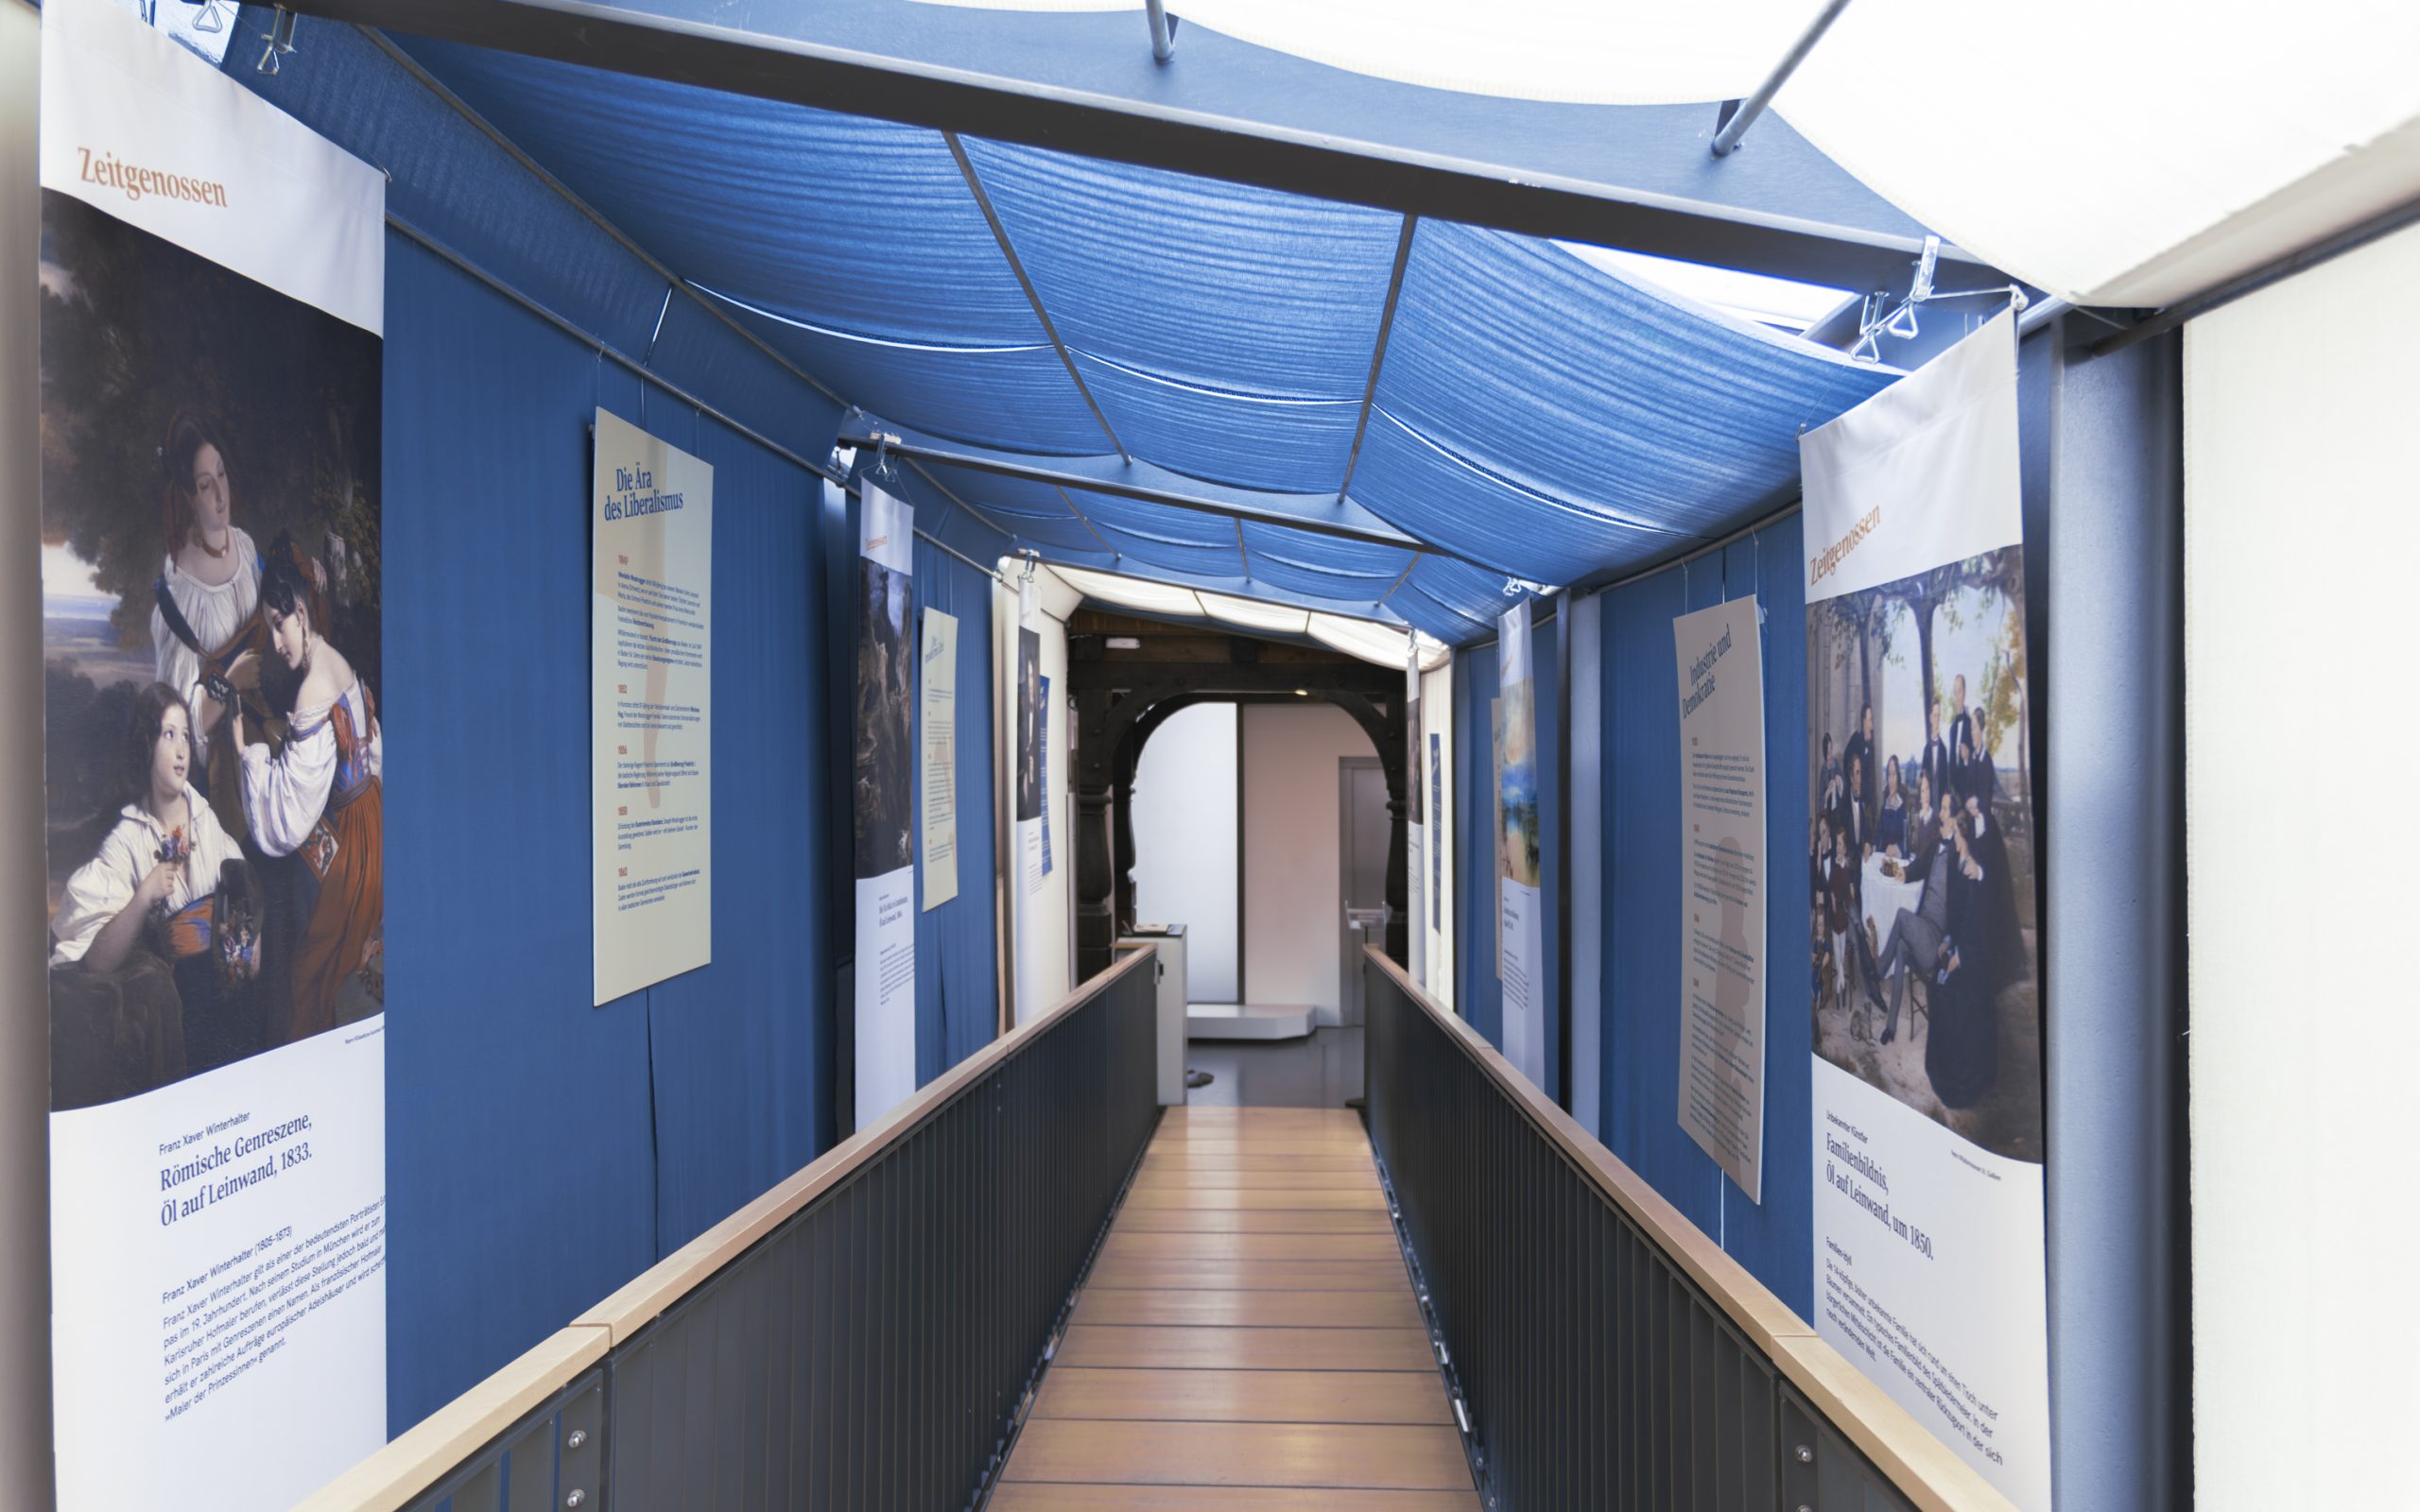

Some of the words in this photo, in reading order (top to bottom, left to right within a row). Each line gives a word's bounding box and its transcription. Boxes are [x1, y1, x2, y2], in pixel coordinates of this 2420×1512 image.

[78, 146, 228, 209] Zeitgenossen
[604, 495, 622, 521] des
[624, 489, 683, 517] Liberalismus
[616, 467, 633, 491] Die
[635, 462, 652, 490] Ära
[1809, 505, 1880, 586] Zeitgenossen
[1689, 643, 1718, 687] Industrie
[1717, 623, 1732, 658] und
[160, 1141, 181, 1155] Franz
[183, 1131, 204, 1145] Xaver
[206, 1112, 250, 1136] Winterhalter
[161, 1146, 231, 1191] Römische
[235, 1115, 311, 1158] Genreszene,
[1826, 1132, 1889, 1195] Familienbildnis,
[162, 1199, 177, 1226] Öl
[182, 1185, 206, 1217] auf
[209, 1156, 277, 1204] Leinwand,
[282, 1143, 312, 1170] 1833.
[1826, 1160, 1835, 1184] Öl
[1836, 1173, 1849, 1194] auf
[1850, 1179, 1892, 1231] Leinwand,
[1893, 1215, 1908, 1240] um
[1910, 1226, 1934, 1261] 1850.
[163, 1286, 184, 1304] Franz
[186, 1273, 208, 1291] Xaver
[210, 1248, 253, 1278] Winterhalter
[164, 1311, 185, 1329] Franz
[187, 1297, 208, 1315] Xaver
[210, 1272, 252, 1302] Winterhalter
[254, 1264, 264, 1280] gilt
[266, 1260, 275, 1270] als
[276, 1249, 292, 1264] einer
[294, 1244, 304, 1255] der
[164, 1333, 178, 1350] pas
[181, 1327, 189, 1338] im
[192, 1318, 200, 1331] 19.
[203, 1293, 248, 1325] Jahrhundert.
[250, 1280, 266, 1297] Nach
[268, 1268, 289, 1287] seinem
[291, 1254, 315, 1273] Studium
[317, 1248, 322, 1258] in
[164, 1336, 204, 1366] Karlsruher
[207, 1315, 238, 1341] Hofmaler
[240, 1299, 267, 1320] berufen,
[268, 1281, 293, 1302] verlässt
[295, 1273, 310, 1287] diese
[312, 1258, 336, 1277] Stellung
[337, 1246, 355, 1265] jedoch
[164, 1368, 181, 1385] sich
[182, 1365, 189, 1374] in
[191, 1351, 209, 1368] Paris
[211, 1342, 221, 1357] mit
[223, 1316, 266, 1348] Genreszenen
[268, 1305, 285, 1320] einen
[286, 1291, 309, 1309] Namen.
[311, 1283, 320, 1294] Als
[165, 1382, 188, 1403] erhält
[190, 1377, 198, 1387] er
[200, 1353, 234, 1382] zahlreiche
[237, 1334, 265, 1358] Aufträge
[194, 1389, 206, 1403] der
[259, 1337, 286, 1363] genannt.
[1962, 1383, 1977, 1406] Tisch
[1978, 1401, 1998, 1420] unter
[1980, 1423, 1993, 1438] der
[1985, 1447, 2002, 1465] sich
